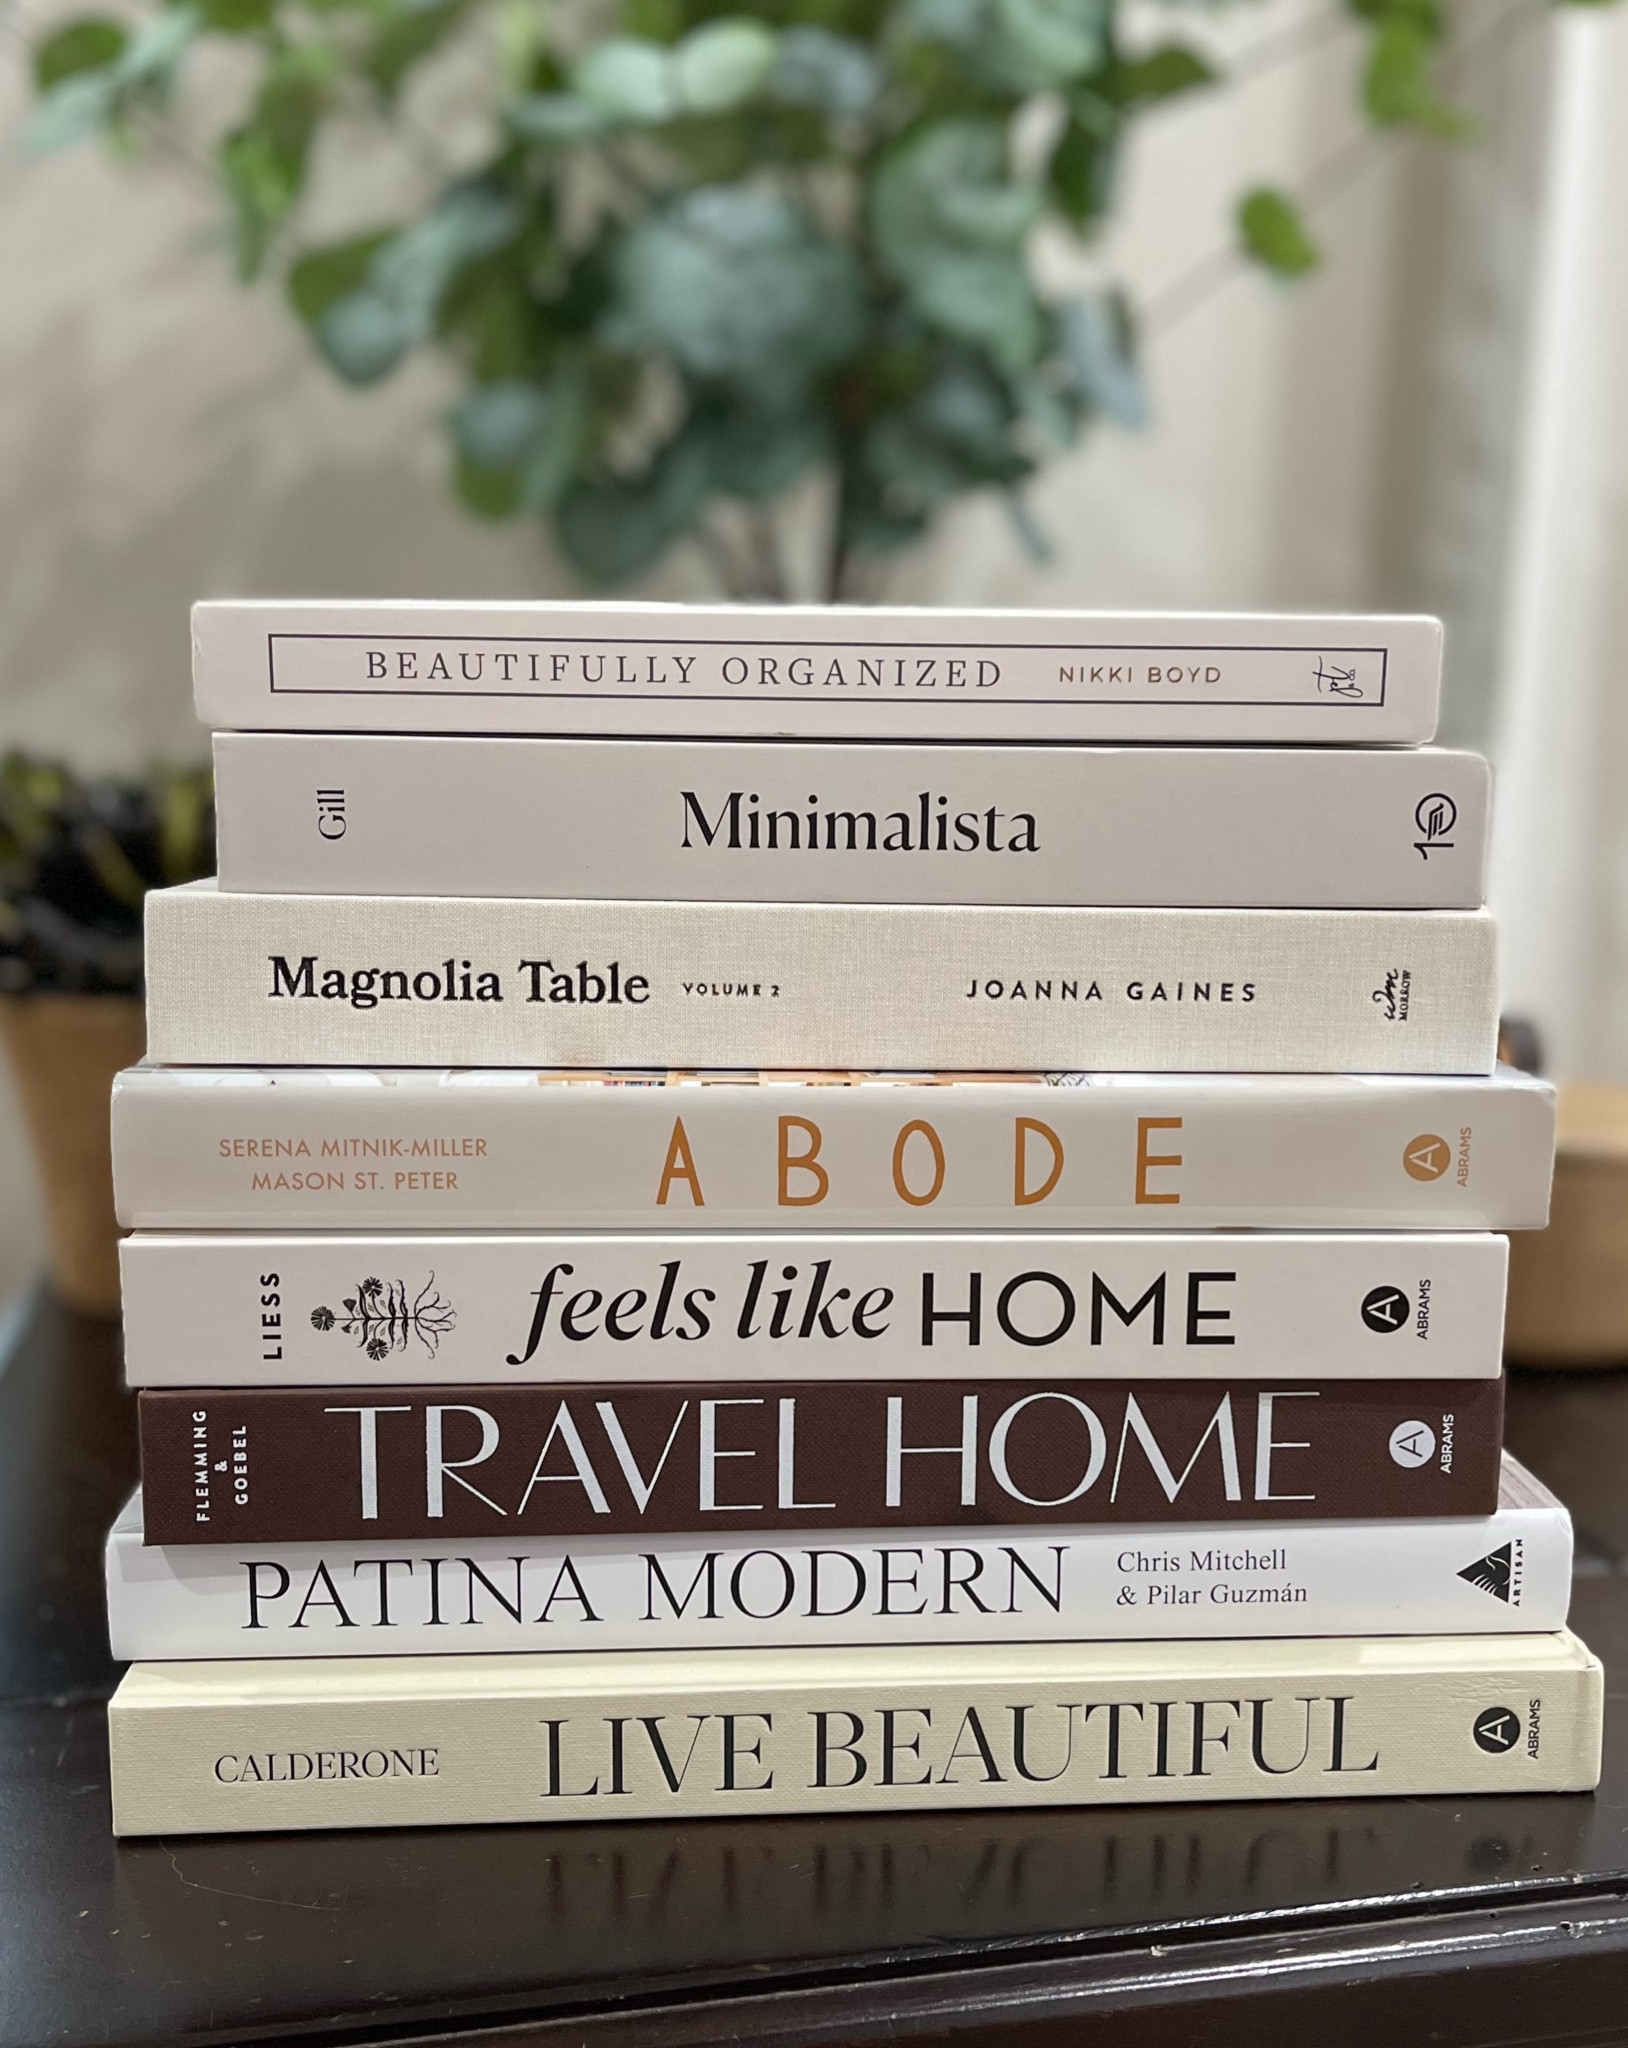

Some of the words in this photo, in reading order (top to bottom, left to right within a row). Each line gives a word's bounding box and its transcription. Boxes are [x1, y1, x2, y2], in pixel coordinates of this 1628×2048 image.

[365, 651, 697, 684] BEAUTIFULLY
[722, 656, 1001, 688] ORGANIZED
[1059, 666, 1132, 683] NIKKI
[1147, 666, 1221, 684] BOYD
[316, 789, 347, 841] Gill
[680, 791, 1041, 853] Minimalista
[267, 955, 504, 1010] Magnolia
[517, 959, 651, 1004] Table
[682, 982, 762, 997] VOLUME
[771, 983, 781, 998] 2
[966, 979, 1103, 1001] JOANNA
[1126, 981, 1255, 1003] GAINES
[1398, 969, 1412, 1021] MORROW
[219, 1138, 312, 1158] SERENA
[320, 1138, 488, 1157] MITNIK-MILLER
[1456, 1126, 1472, 1188] ABRAMS
[251, 1172, 345, 1191] MASON
[354, 1171, 385, 1190] ST.
[394, 1171, 458, 1190] PETER
[259, 1273, 283, 1360] LIESS
[505, 1260, 716, 1366] feels
[737, 1259, 894, 1340] like
[921, 1271, 1237, 1347] HOME
[1416, 1279, 1432, 1340] ABRAMS
[192, 1410, 211, 1522] FLEMMING
[214, 1460, 228, 1472] &
[232, 1425, 249, 1505] GOEBEL
[323, 1397, 837, 1520] TRAVEL
[885, 1391, 1320, 1507] HOME
[1440, 1413, 1454, 1474] ABRAMS
[238, 1553, 604, 1629] PATINA
[638, 1546, 1070, 1621] MODERN
[1117, 1550, 1180, 1573] Chris
[1190, 1548, 1286, 1571] Mitchell
[1512, 1539, 1523, 1607] ARTISAN
[1116, 1585, 1137, 1606] &
[1148, 1584, 1202, 1605] Pilar
[1210, 1582, 1307, 1604] Guzmán
[539, 1713, 774, 1797] LIVE
[806, 1696, 1379, 1788] BEAUTIFUL
[1527, 1699, 1541, 1760] ABRAMS
[214, 1748, 440, 1783] CALDERONE
